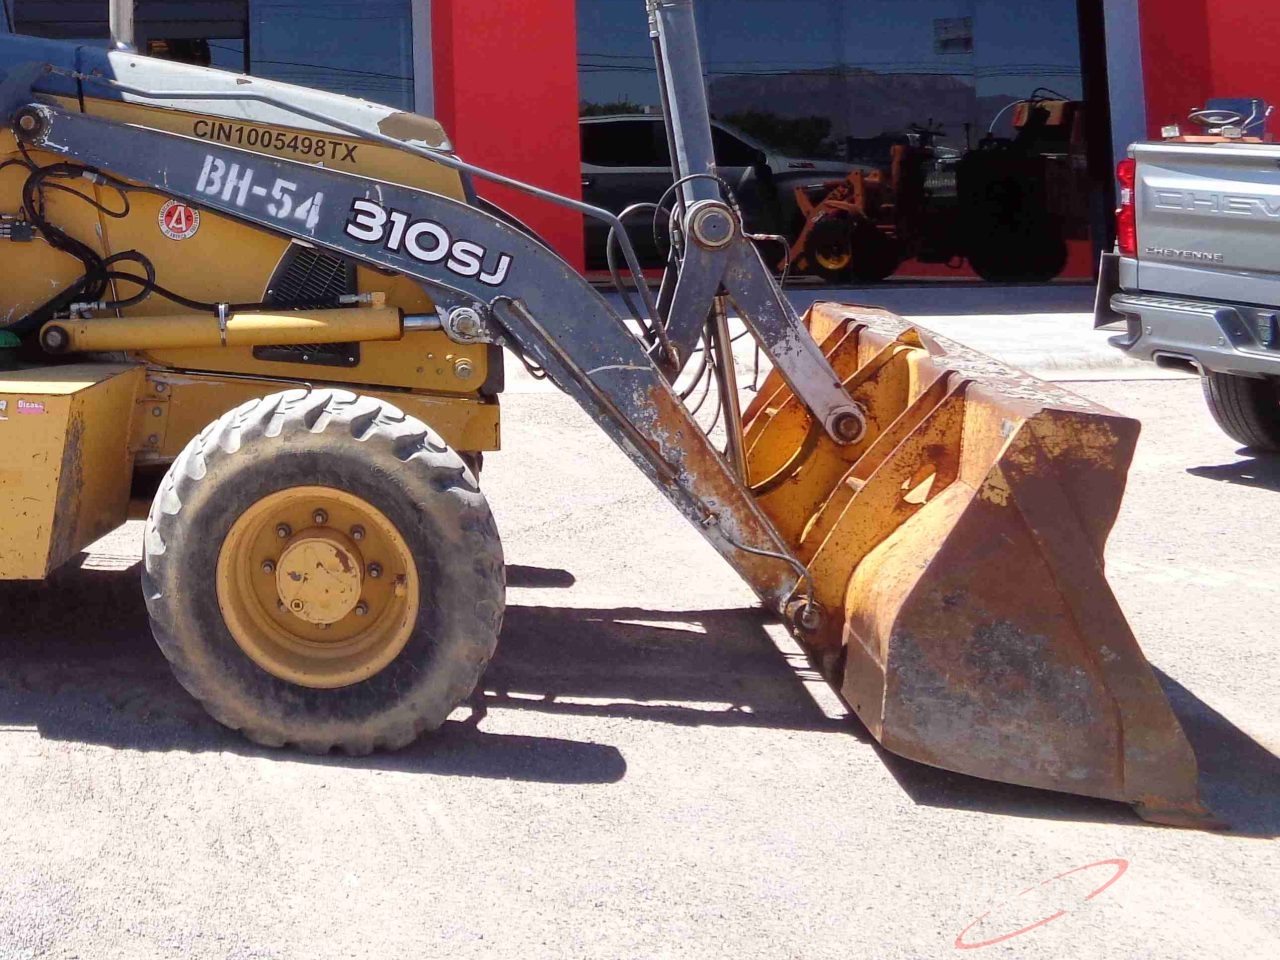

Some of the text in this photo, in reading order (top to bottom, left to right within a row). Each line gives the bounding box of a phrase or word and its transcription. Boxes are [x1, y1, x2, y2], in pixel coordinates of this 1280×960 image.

[192, 118, 360, 164] CIN1005498TX
[195, 153, 325, 230] BH-54
[344, 197, 513, 287] 310SJ
[1145, 247, 1224, 263] CHEYENNE
